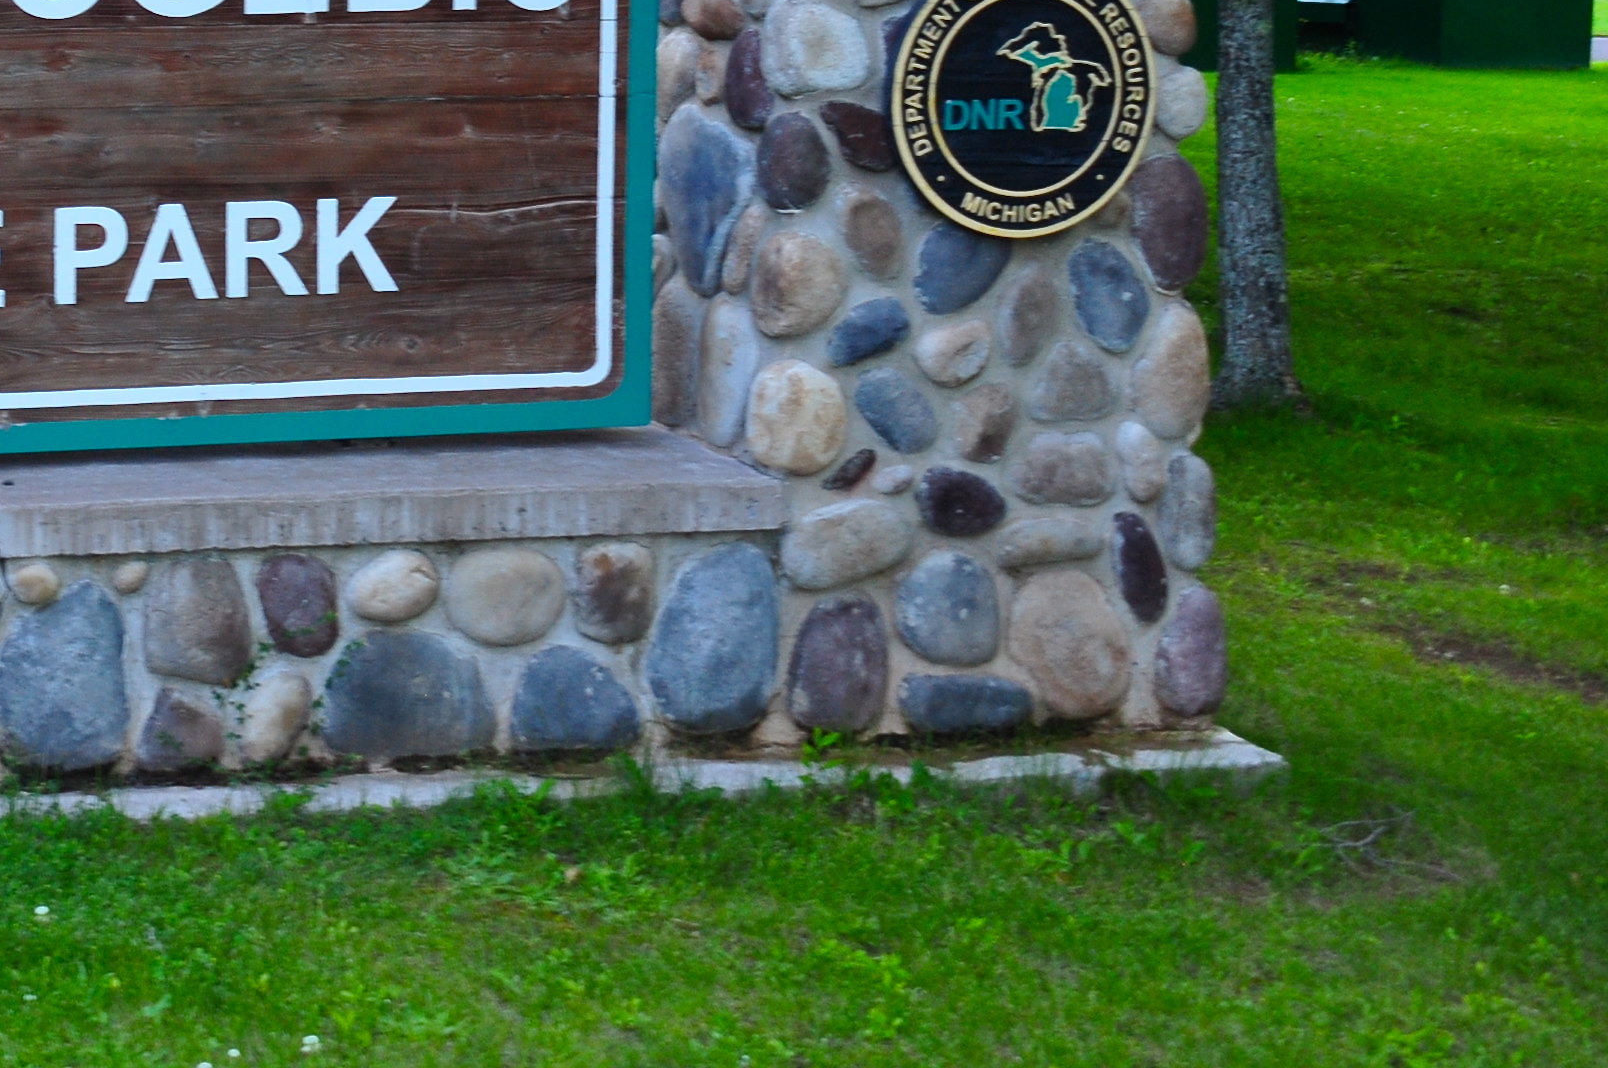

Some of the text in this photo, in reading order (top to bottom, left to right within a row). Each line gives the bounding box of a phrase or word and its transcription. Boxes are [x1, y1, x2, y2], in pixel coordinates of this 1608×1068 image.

[1099, 2, 1144, 154] RESOURCES
[943, 98, 1025, 131] DNR
[960, 191, 1076, 223] MICHIGAN
[53, 196, 400, 305] PARK
